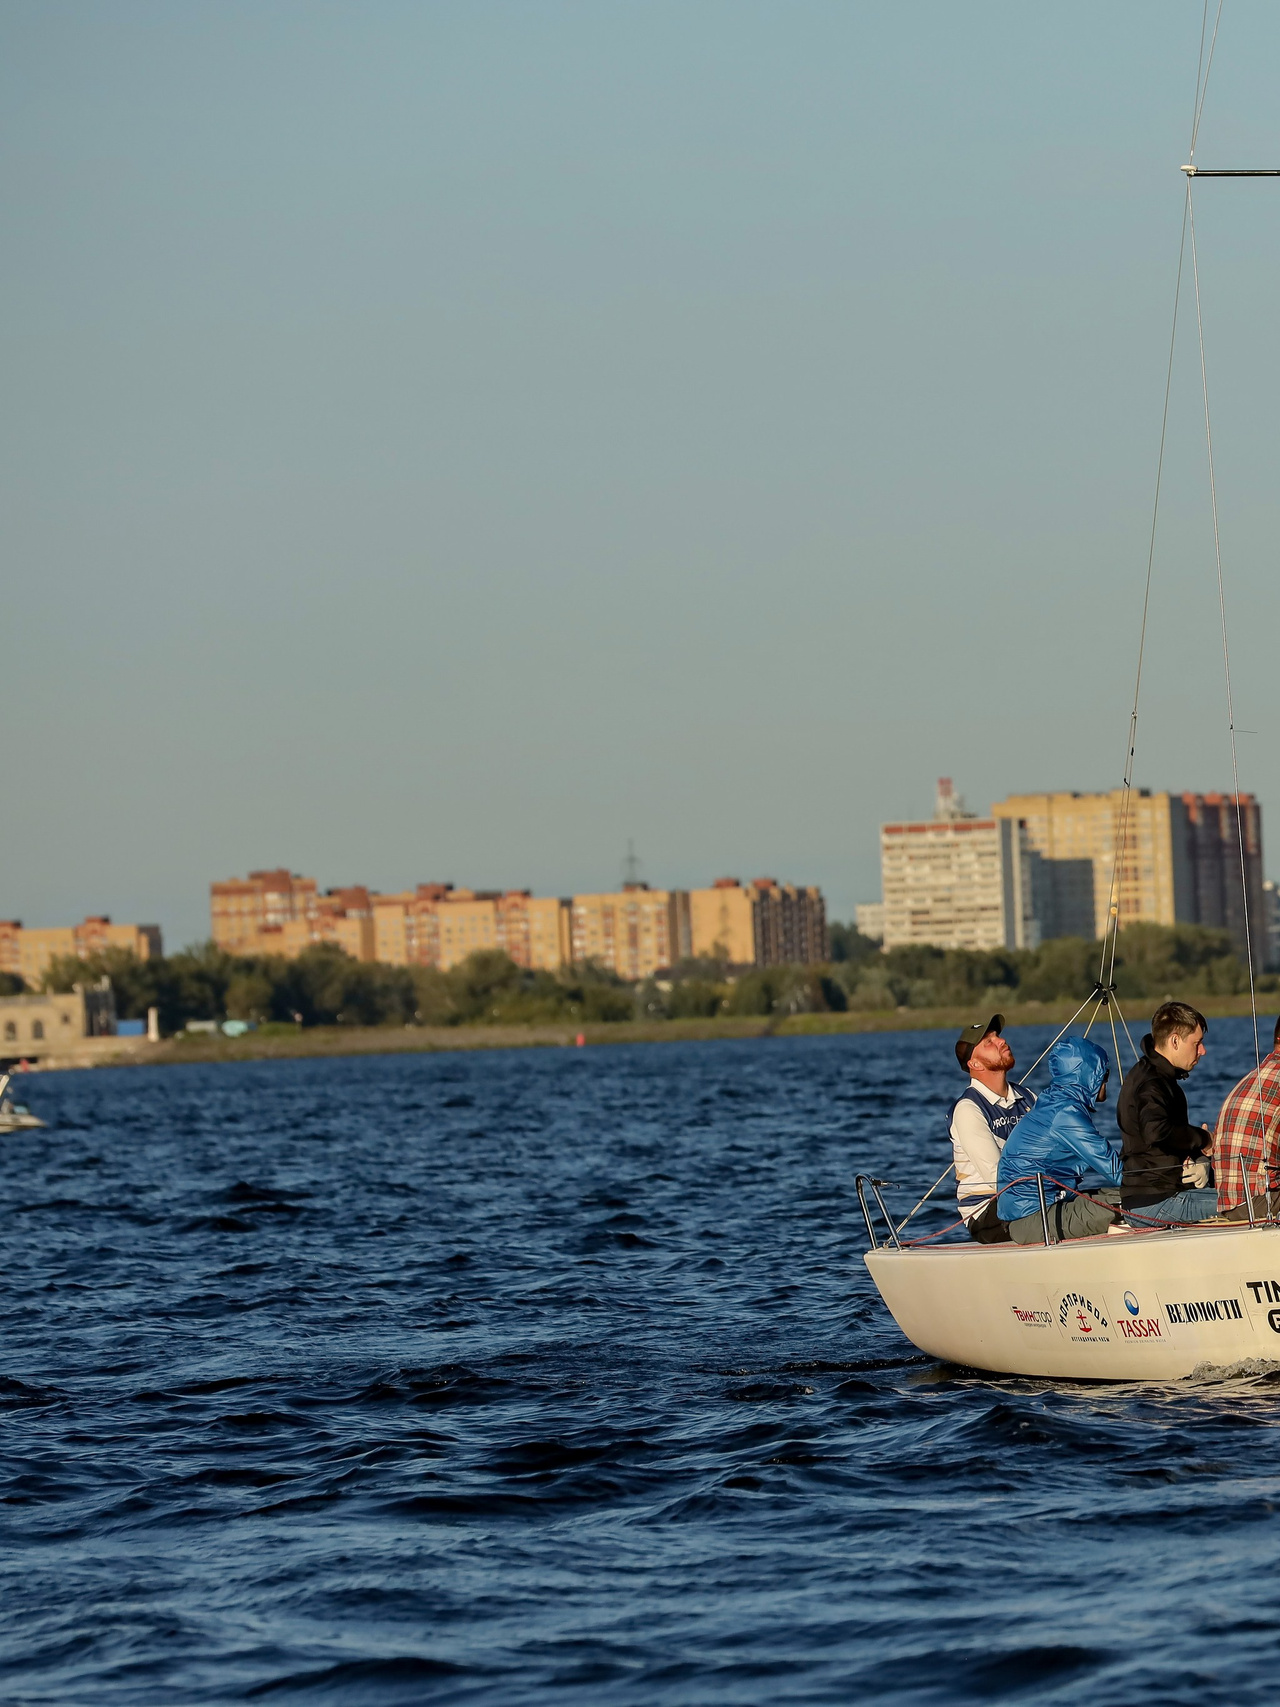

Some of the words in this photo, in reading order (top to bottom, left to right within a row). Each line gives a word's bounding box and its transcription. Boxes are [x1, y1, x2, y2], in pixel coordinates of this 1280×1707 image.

[1059, 1292, 1108, 1328] МОРПРИБОР
[1164, 1298, 1244, 1325] ВЕДОМОСТИ
[1116, 1318, 1162, 1338] TASSAY
